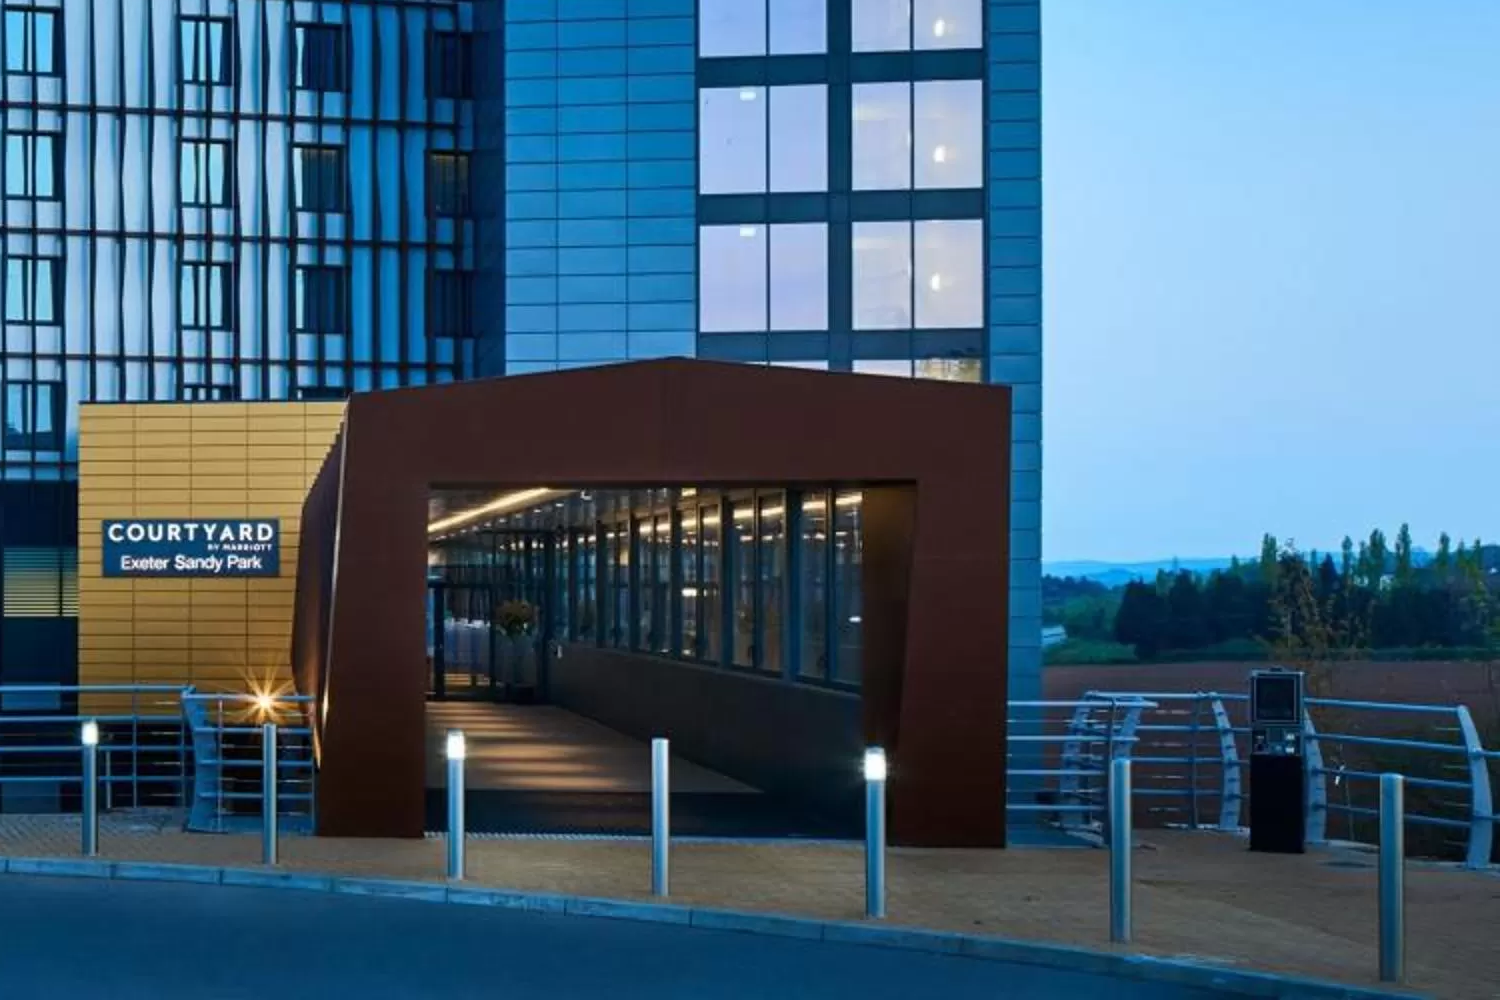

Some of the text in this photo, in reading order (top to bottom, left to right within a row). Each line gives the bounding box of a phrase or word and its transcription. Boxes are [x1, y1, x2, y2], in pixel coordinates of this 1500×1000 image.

[107, 523, 273, 542] COURTYARD
[120, 554, 262, 573] Exeter Sandy Park
